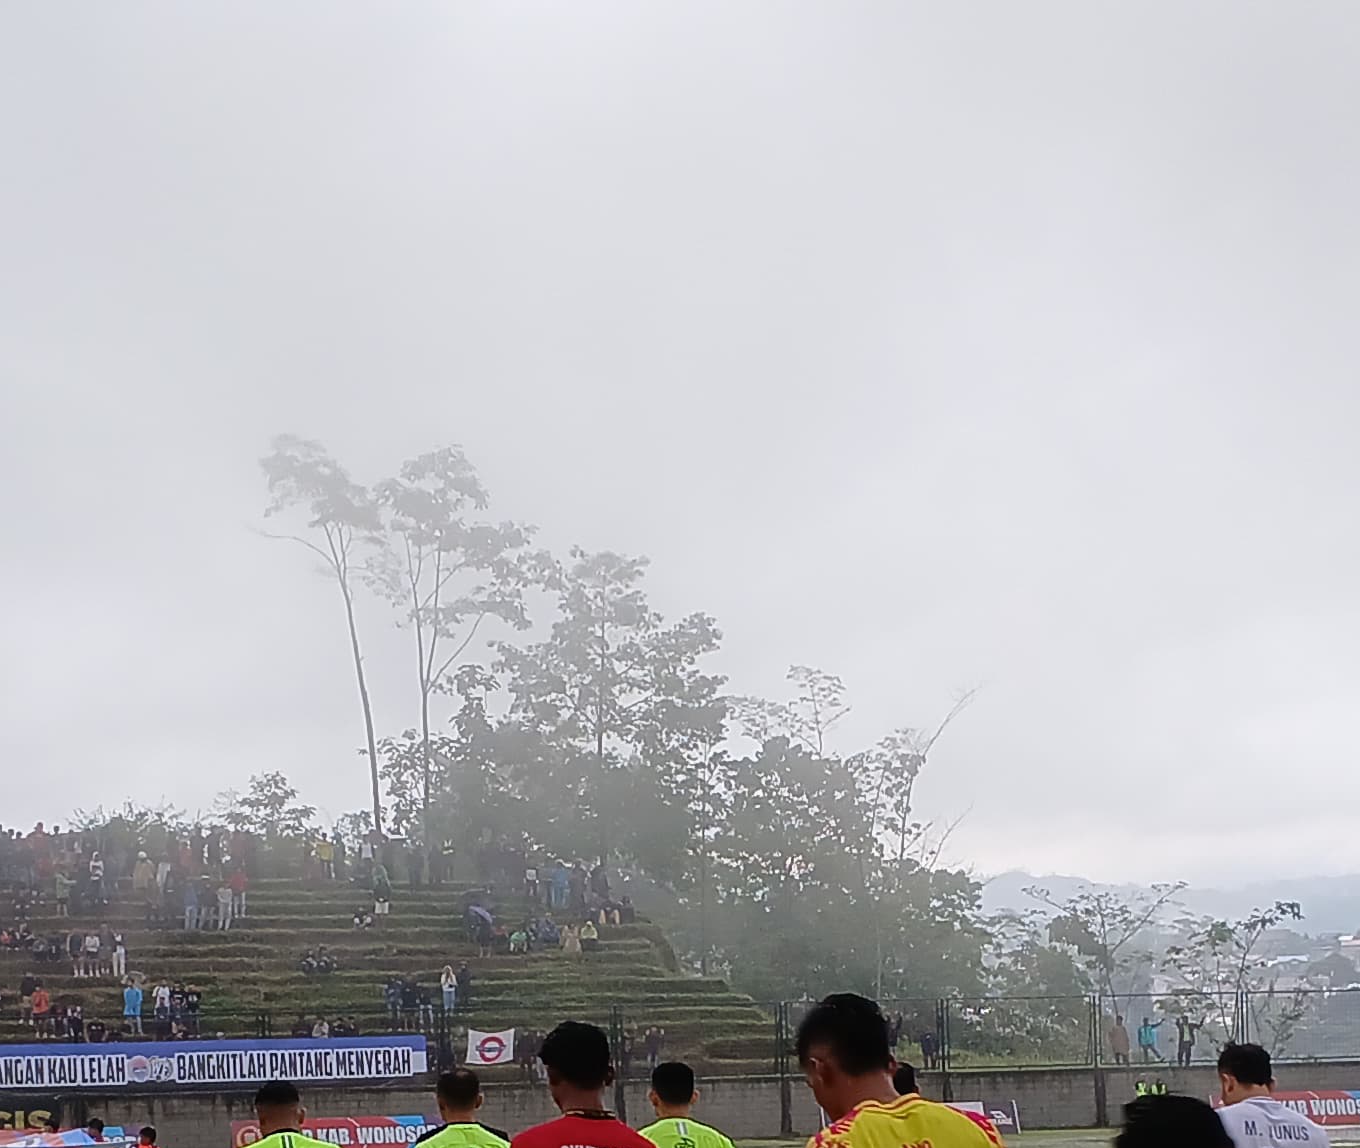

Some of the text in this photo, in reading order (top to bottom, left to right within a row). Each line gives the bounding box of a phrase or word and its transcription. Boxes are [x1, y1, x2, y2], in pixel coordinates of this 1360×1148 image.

[47, 1055, 78, 1085] KAU
[80, 1054, 127, 1084] LELAH
[176, 1052, 266, 1081] BANGKITLAH
[269, 1050, 333, 1080] PANTANG
[336, 1048, 411, 1078] MENYERAH
[357, 1123, 443, 1145] WONOSO
[1244, 1120, 1263, 1137] M.
